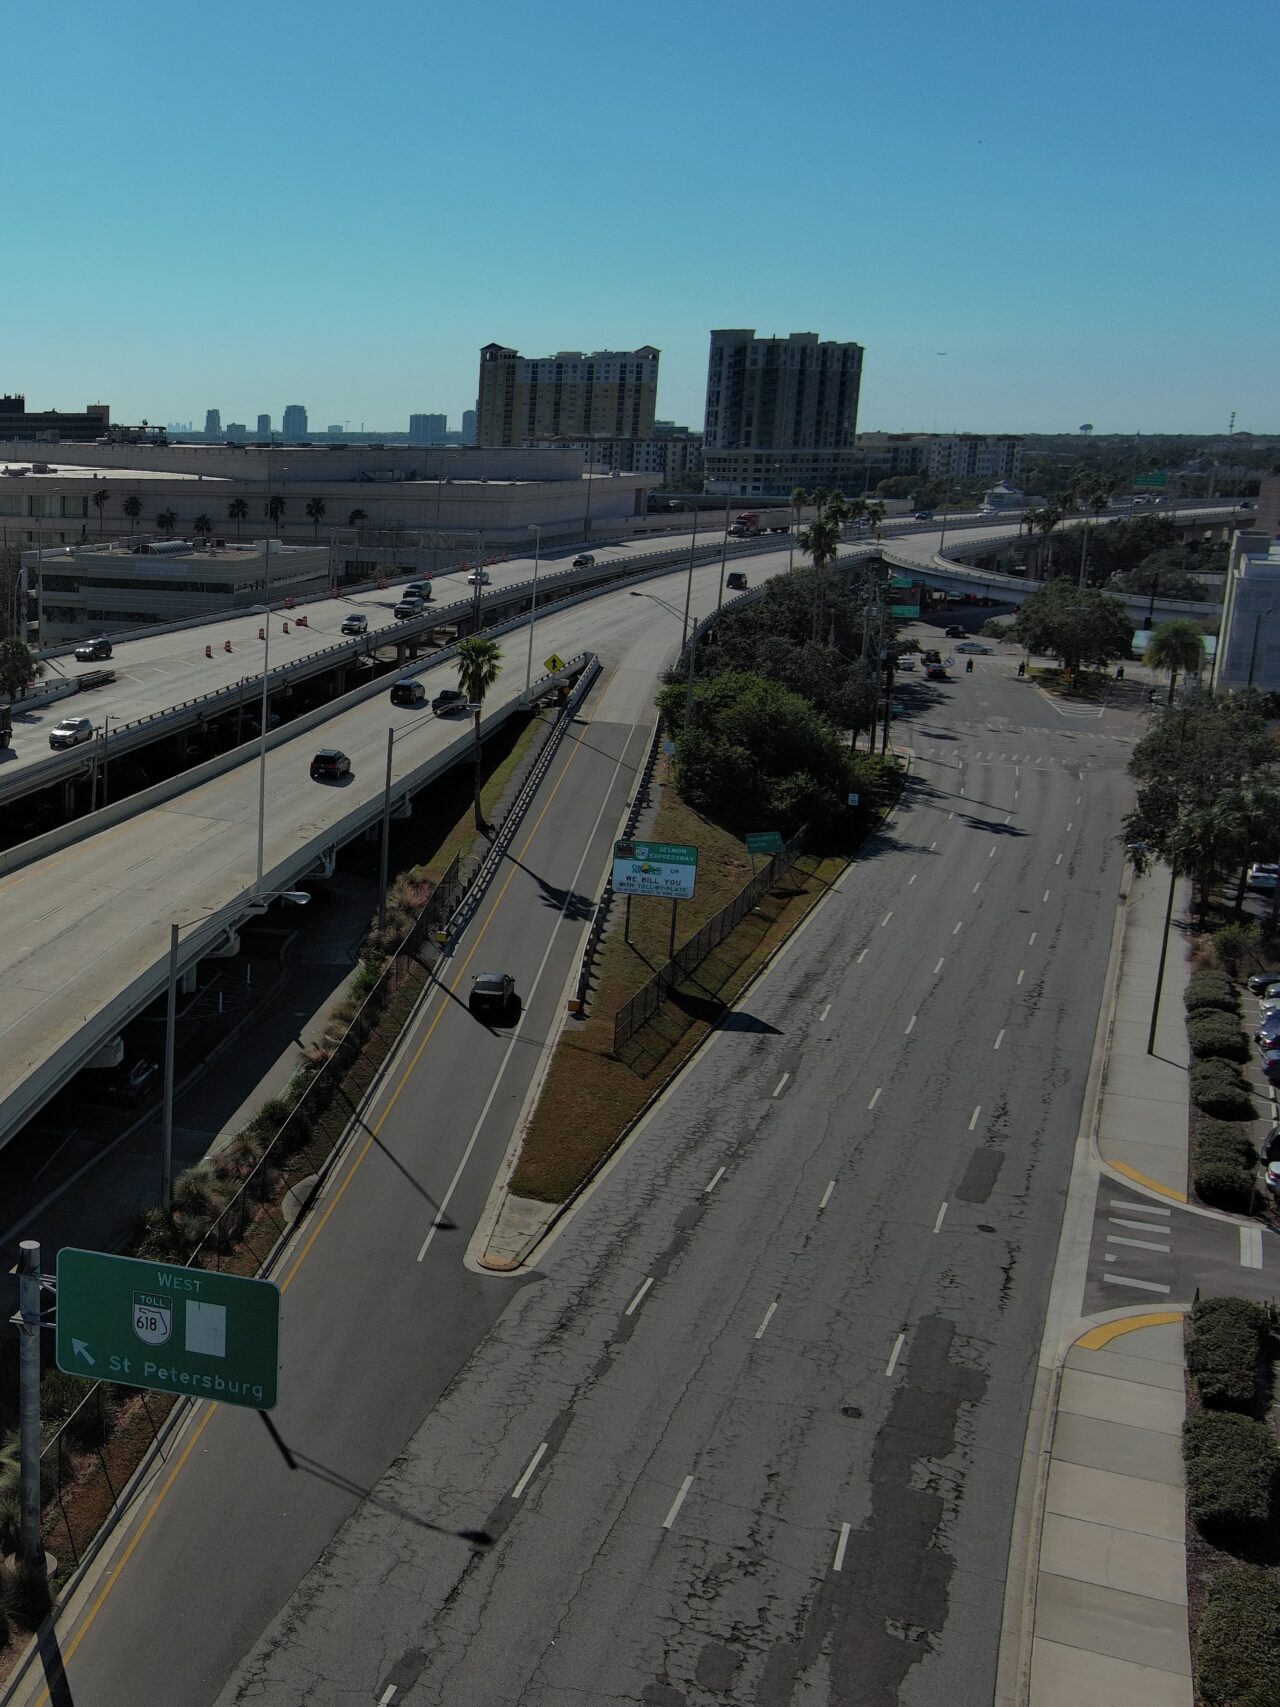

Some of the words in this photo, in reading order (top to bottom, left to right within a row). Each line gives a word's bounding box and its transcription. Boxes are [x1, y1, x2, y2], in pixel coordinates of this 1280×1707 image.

[659, 846, 687, 854] SELMON
[649, 853, 695, 862] EXPRESSWAY
[638, 884, 688, 893] TOLL-BY-PLATE
[157, 1272, 203, 1293] WEST
[140, 1295, 166, 1307] TOLL
[136, 1315, 157, 1331] 618
[109, 1356, 131, 1373] St
[144, 1361, 263, 1401] Petersburg
